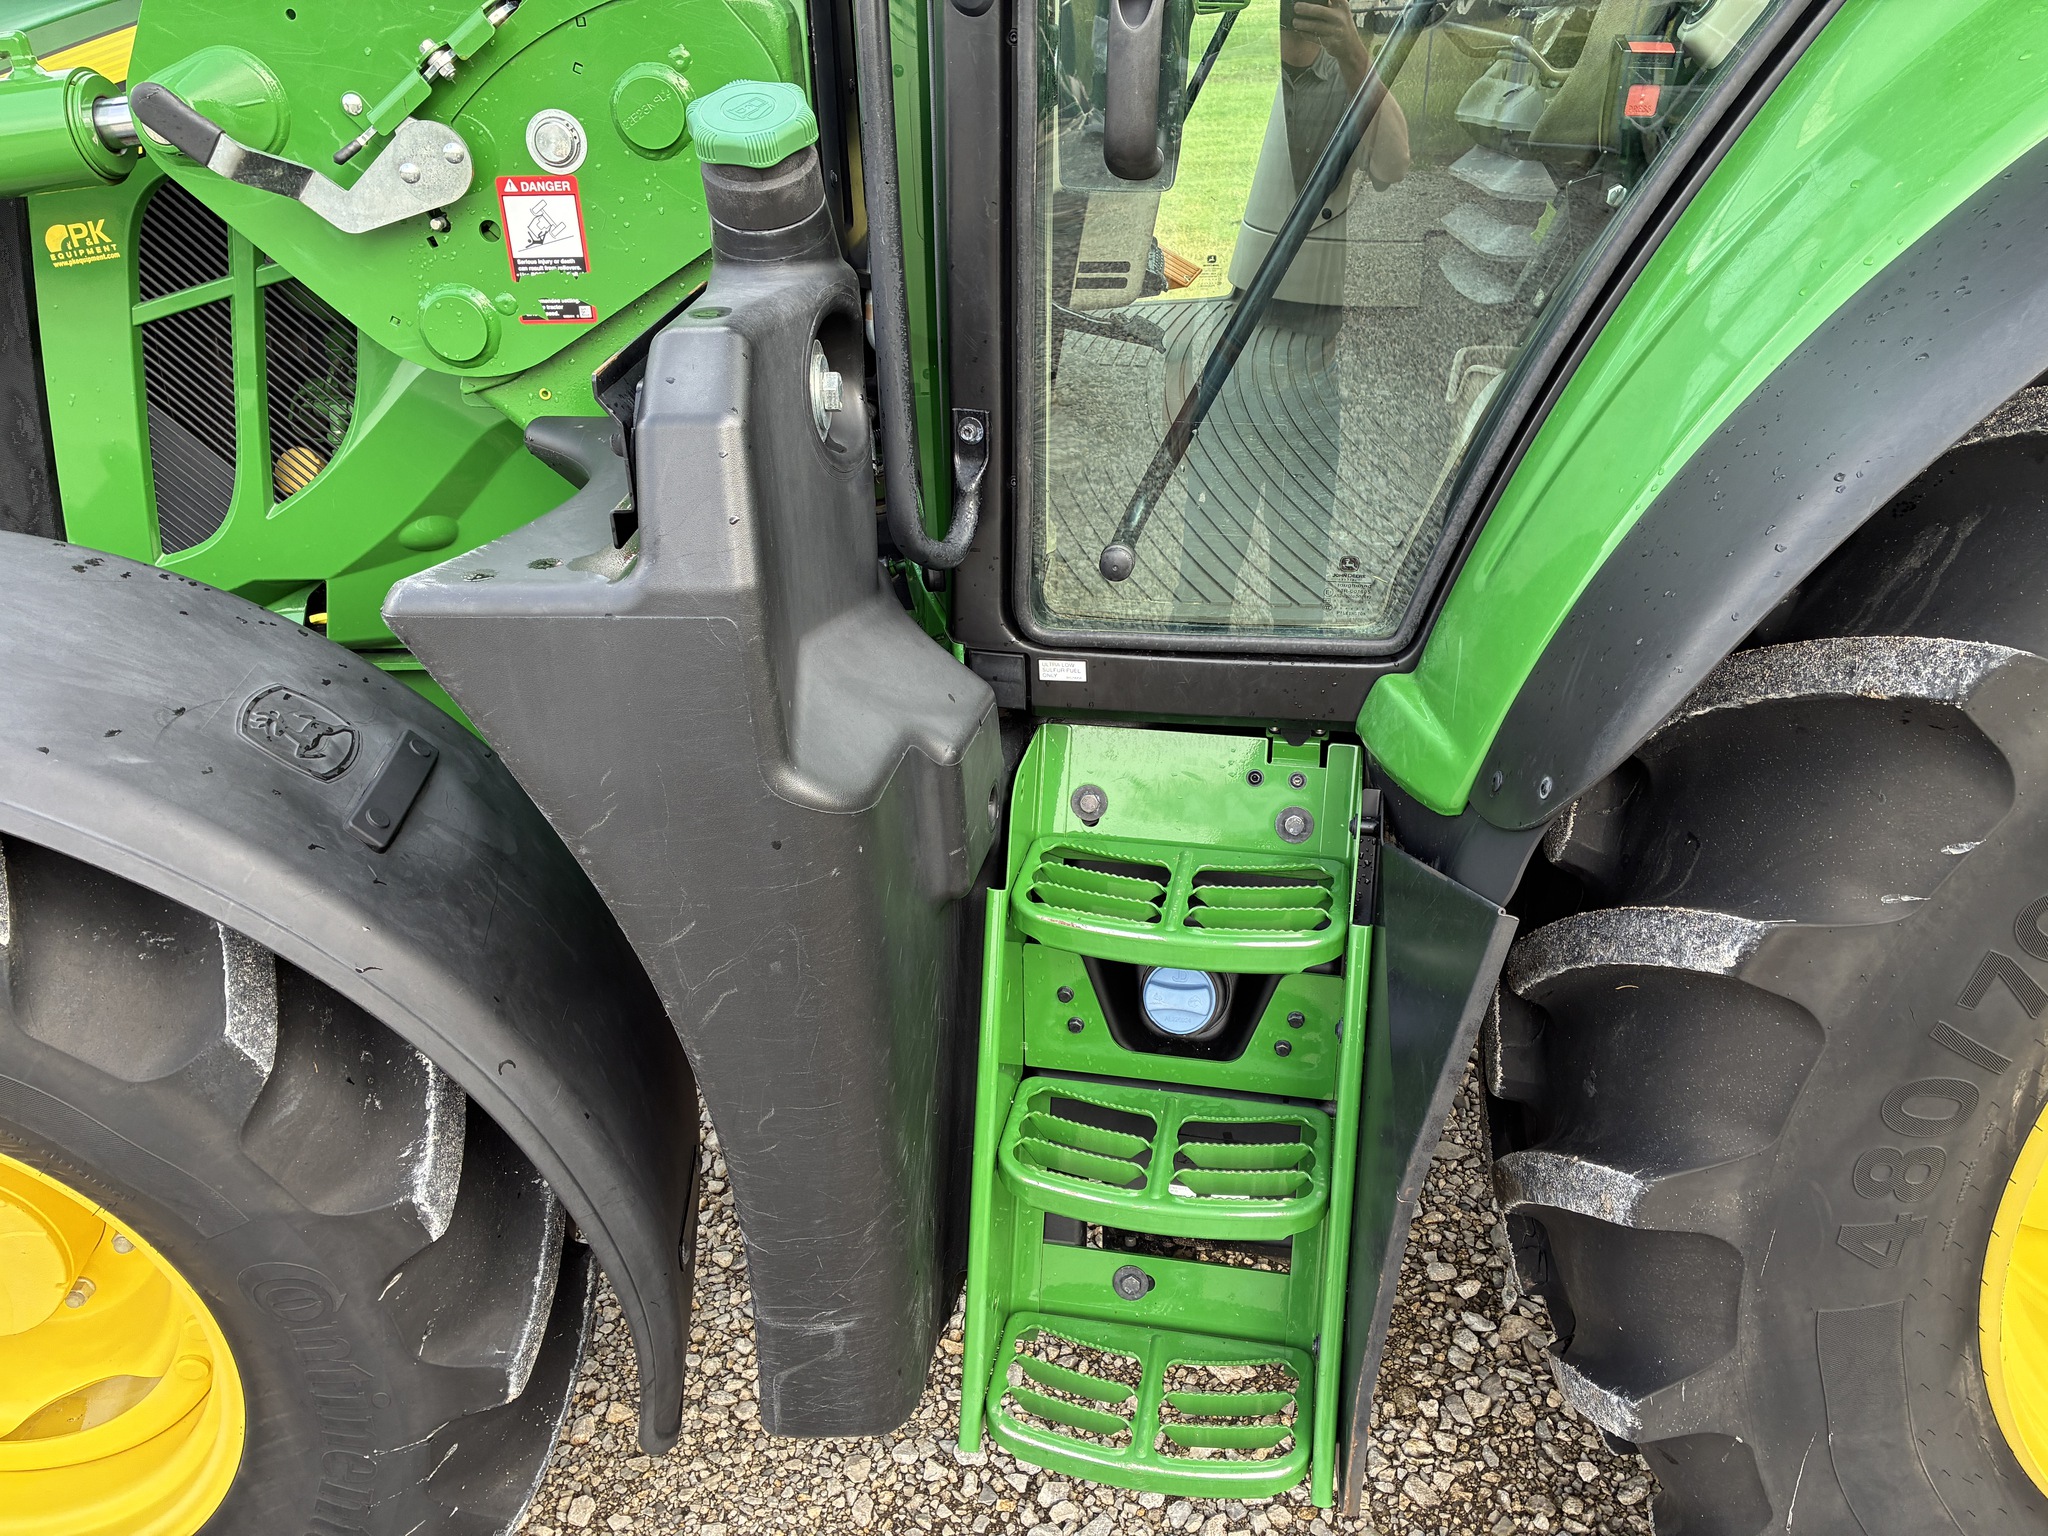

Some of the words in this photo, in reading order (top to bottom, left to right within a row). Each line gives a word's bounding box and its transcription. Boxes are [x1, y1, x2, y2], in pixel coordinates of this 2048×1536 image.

[1628, 104, 1652, 113] PRESS
[520, 180, 572, 192] DANGER
[49, 243, 117, 261] EQUIPMENT
[53, 251, 121, 268] www.pkequipment.com
